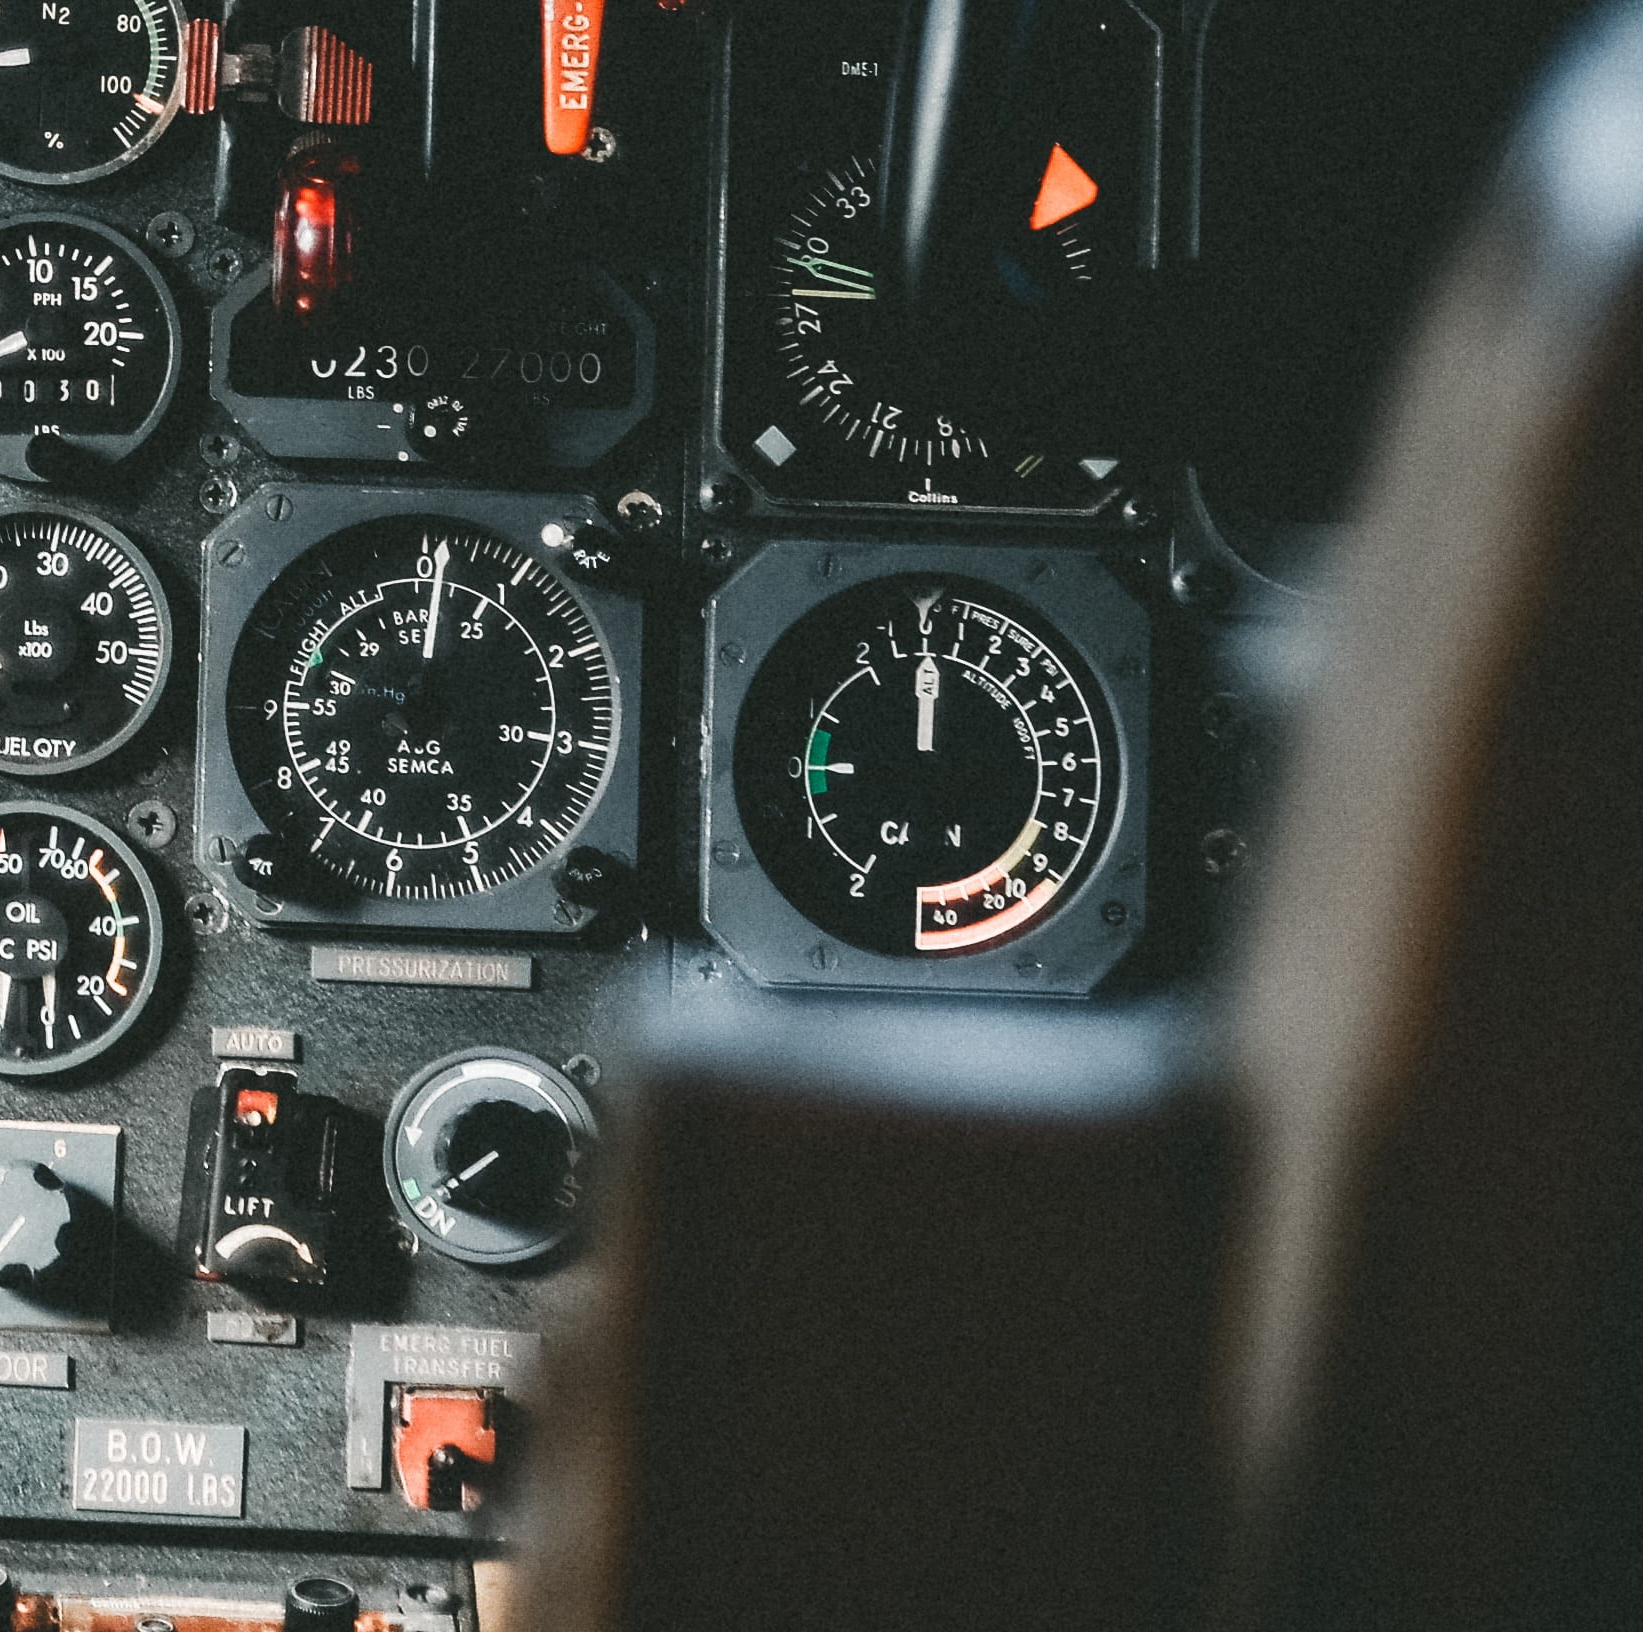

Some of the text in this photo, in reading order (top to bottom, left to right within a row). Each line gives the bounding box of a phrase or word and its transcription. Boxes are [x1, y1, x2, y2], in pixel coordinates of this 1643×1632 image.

[387, 758, 454, 775] SEMCA
[339, 956, 509, 982] PRESSURIZATION
[224, 1196, 275, 1218] LIFT
[83, 1470, 168, 1504] 22000
